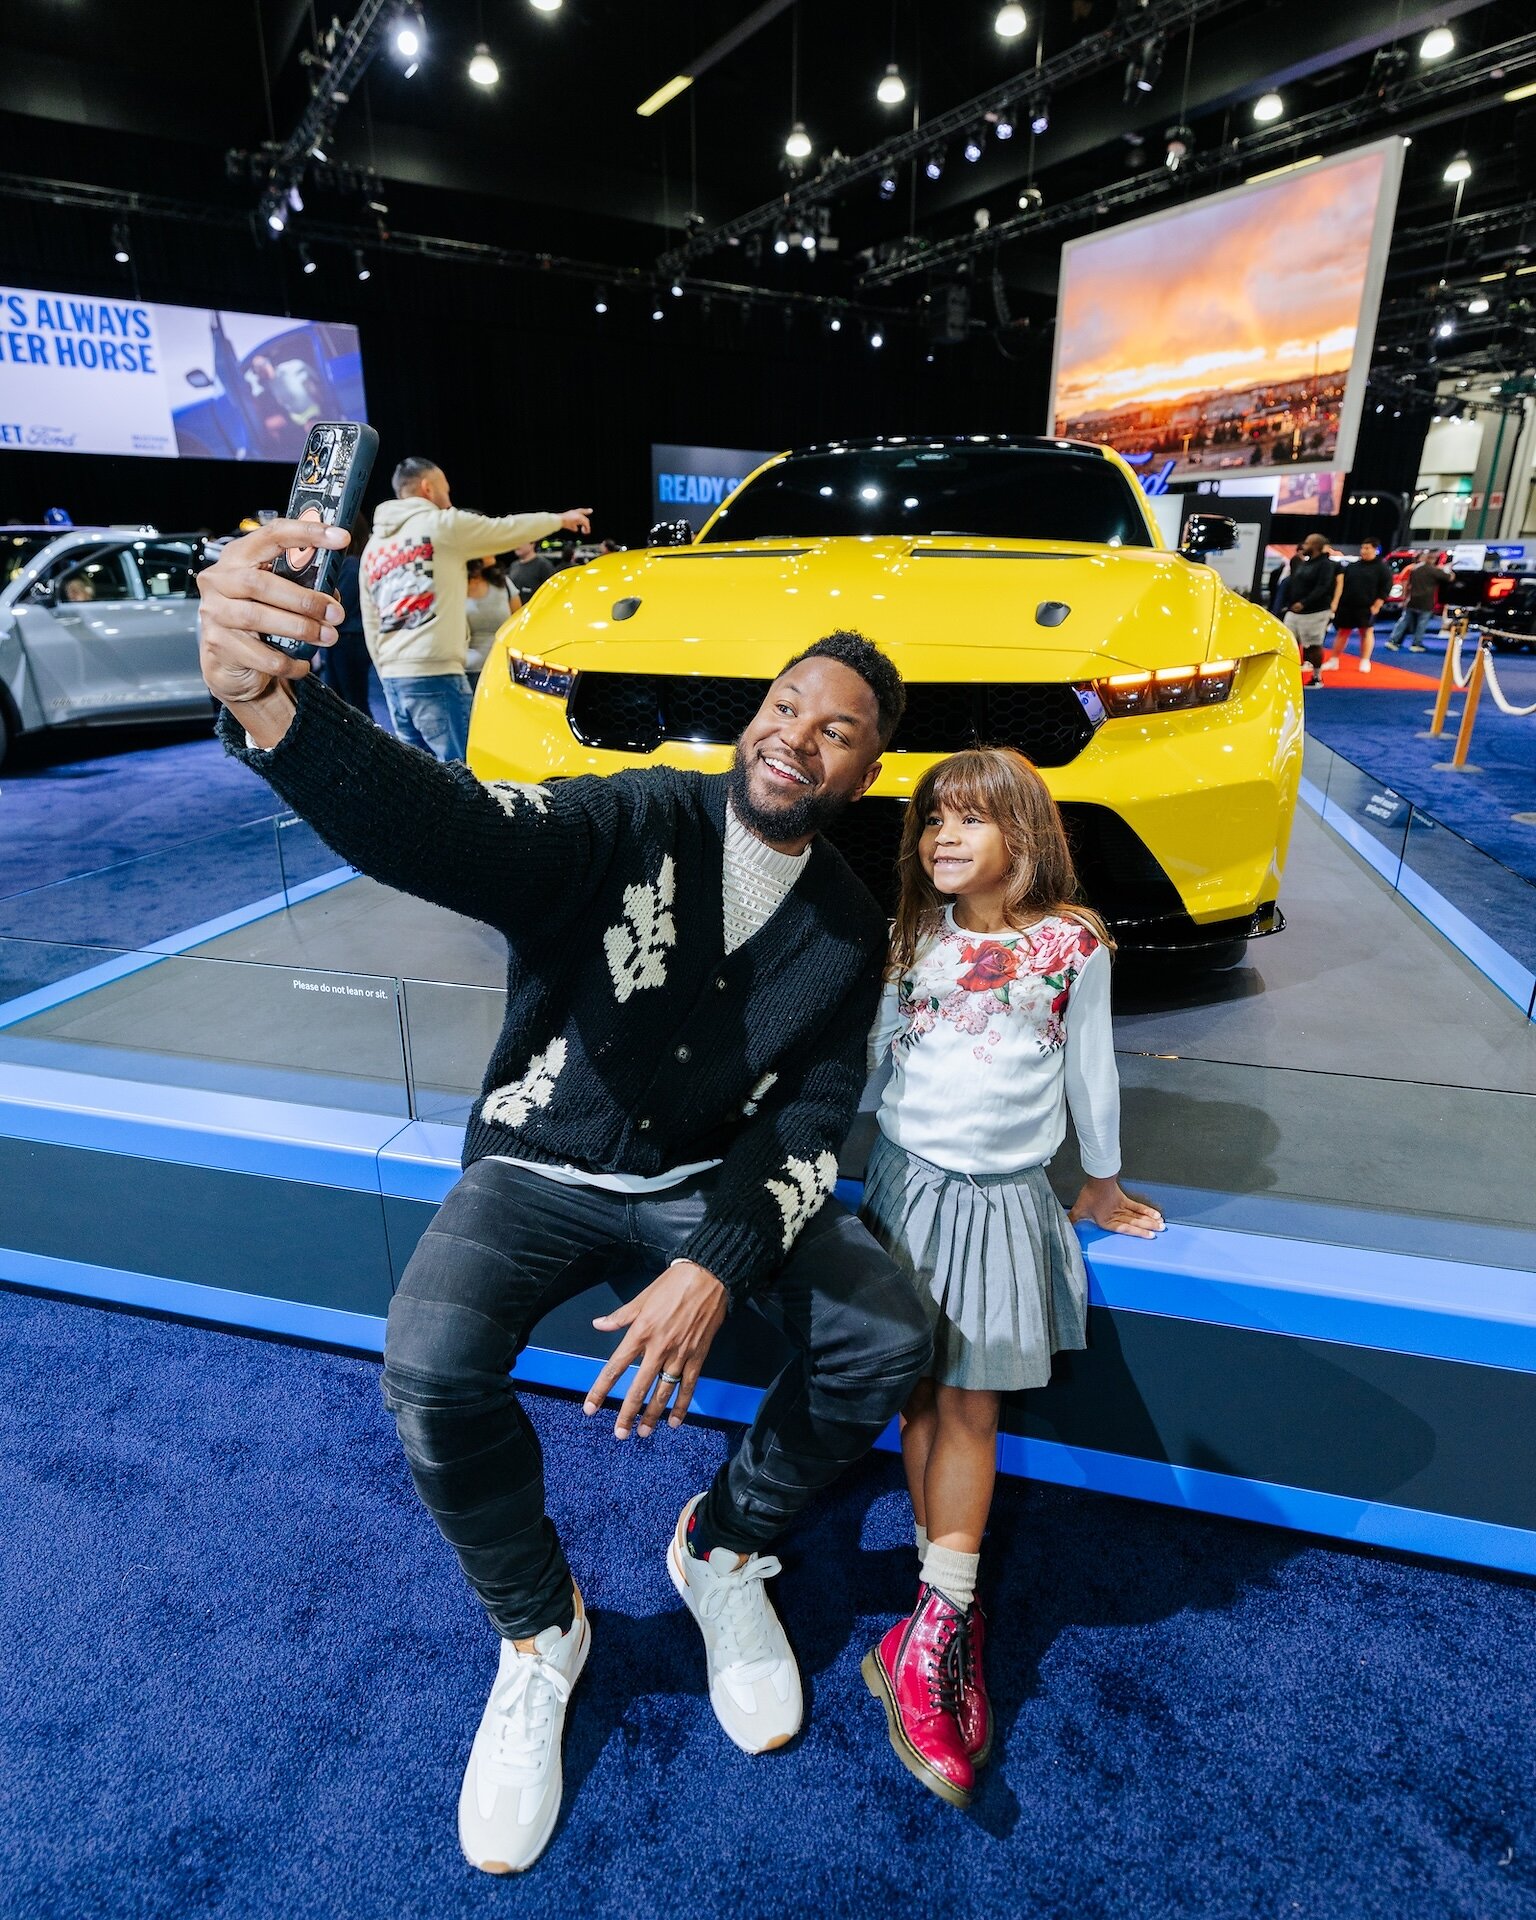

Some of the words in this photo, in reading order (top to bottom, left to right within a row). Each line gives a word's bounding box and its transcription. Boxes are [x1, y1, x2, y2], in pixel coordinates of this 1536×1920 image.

[37, 299, 151, 339] ALWAYS
[55, 336, 156, 374] HORSE
[0, 424, 21, 443] ET
[659, 473, 724, 505] READY
[293, 980, 319, 992] Please
[320, 984, 331, 993] do
[332, 986, 346, 995] not
[347, 987, 364, 997] lean
[365, 990, 374, 998] or
[375, 990, 388, 999] sit.
